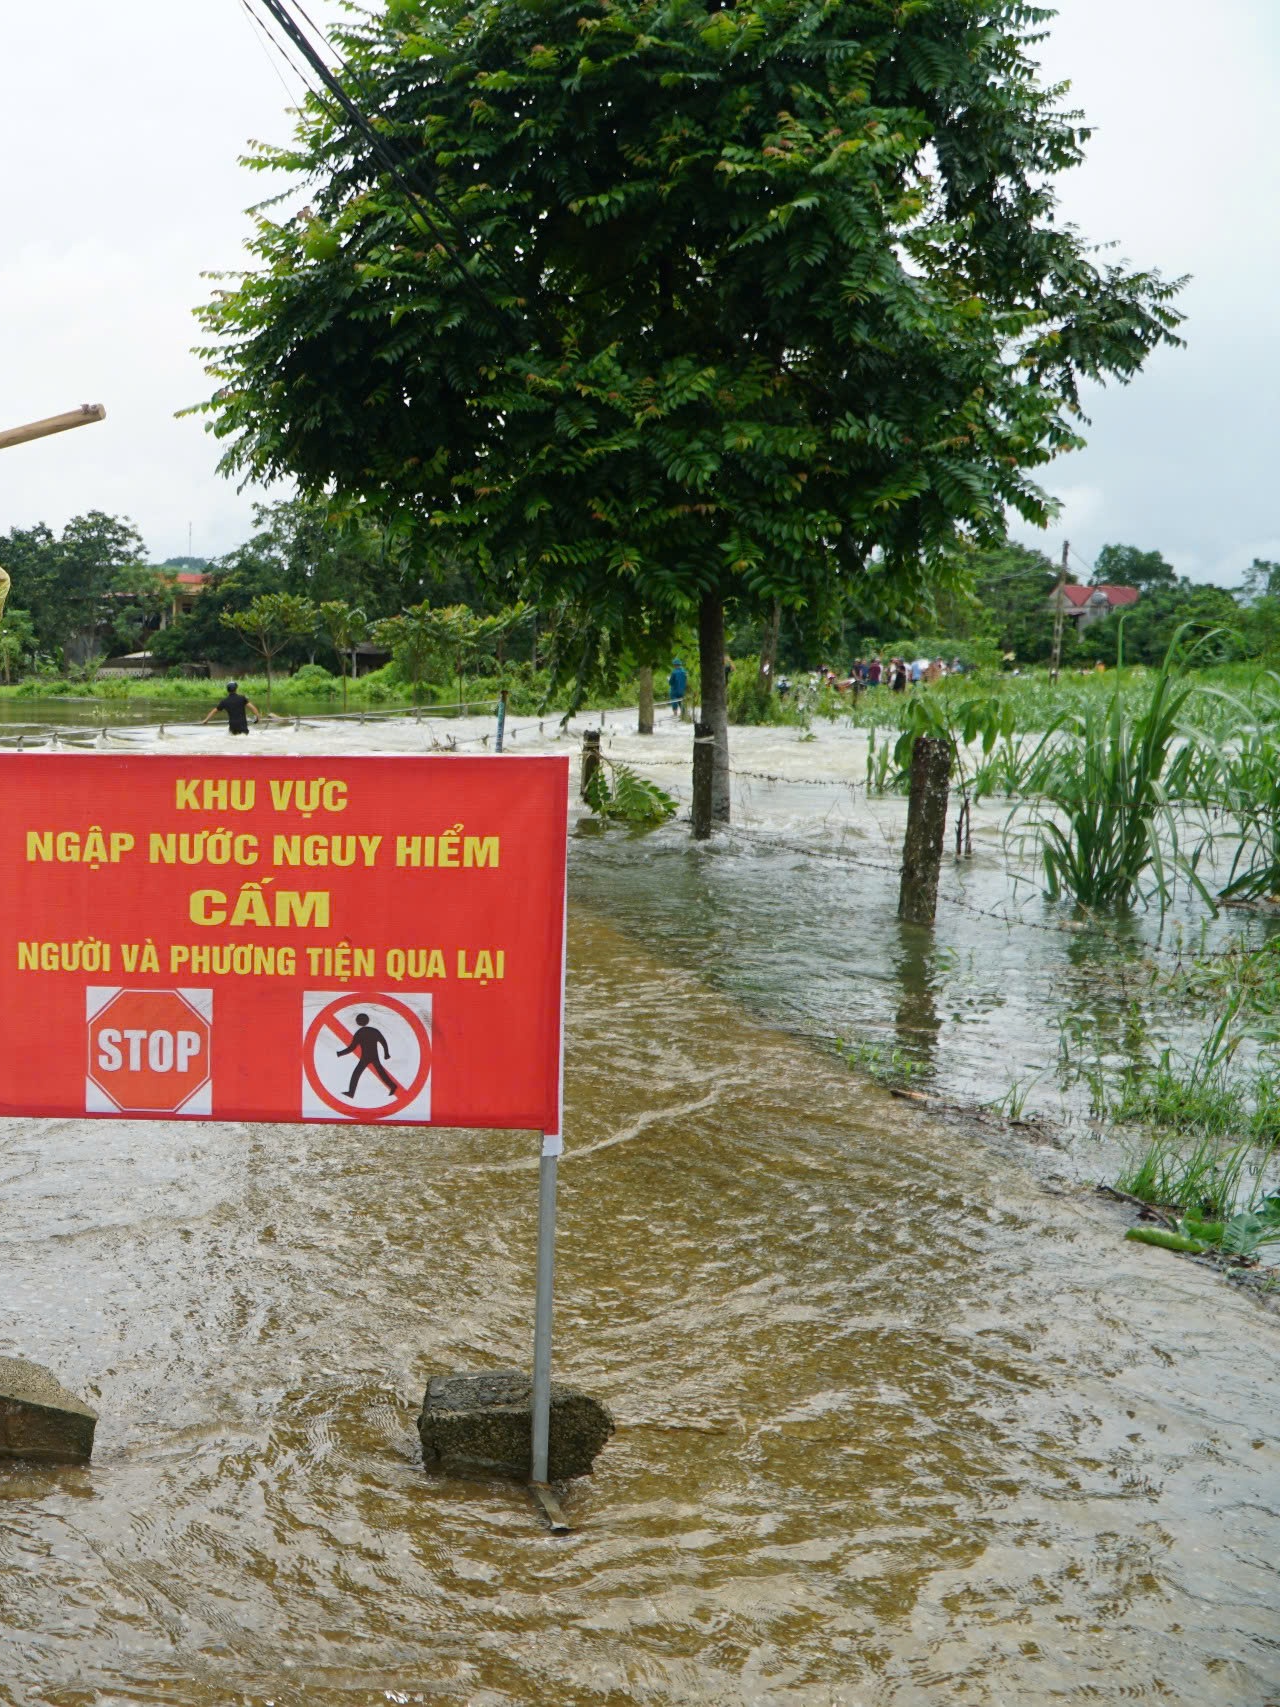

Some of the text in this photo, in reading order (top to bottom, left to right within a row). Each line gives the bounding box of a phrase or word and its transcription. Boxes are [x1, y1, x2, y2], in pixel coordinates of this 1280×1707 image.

[175, 777, 348, 819] KHU VỰC
[26, 823, 500, 870] NGẬP NƯỚC NGUY HIỂM
[188, 876, 330, 928] CẤM
[17, 936, 505, 986] NGƯỜI VÀ PHƯƠNG TIỆN QUA LẠI
[97, 1028, 202, 1073] STOP
